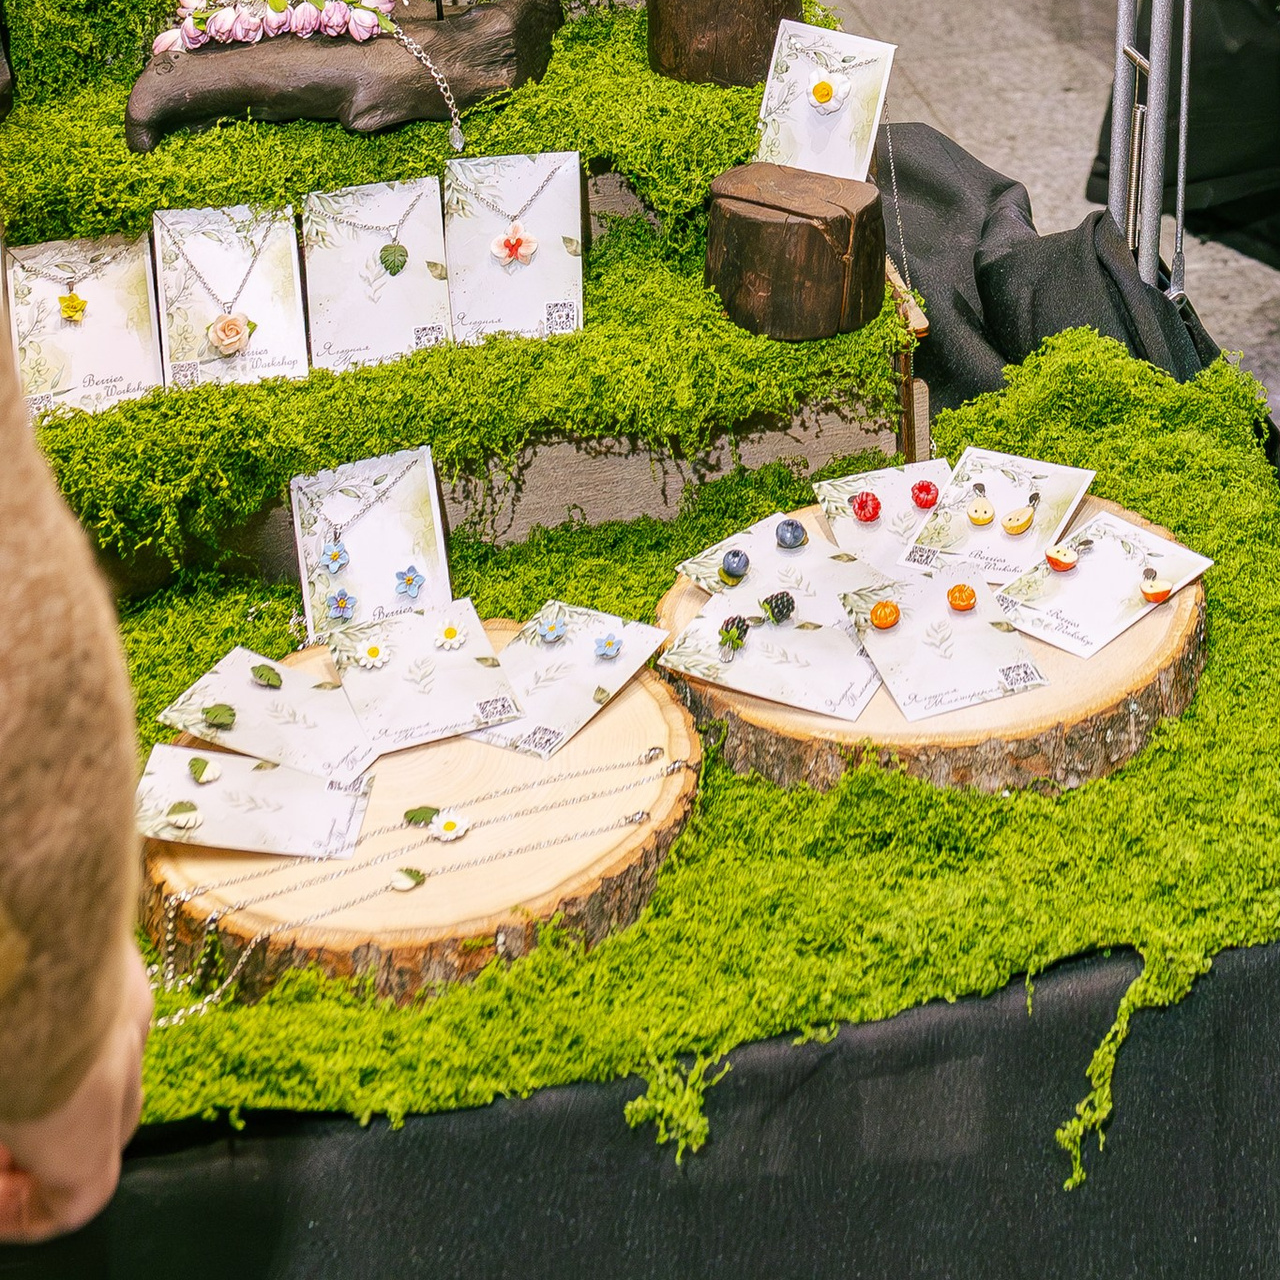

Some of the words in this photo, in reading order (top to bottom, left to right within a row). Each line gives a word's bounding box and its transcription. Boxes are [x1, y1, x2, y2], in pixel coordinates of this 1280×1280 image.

[249, 355, 298, 370] Workshop
[82, 373, 124, 388] Berries
[372, 605, 413, 621] Berries
